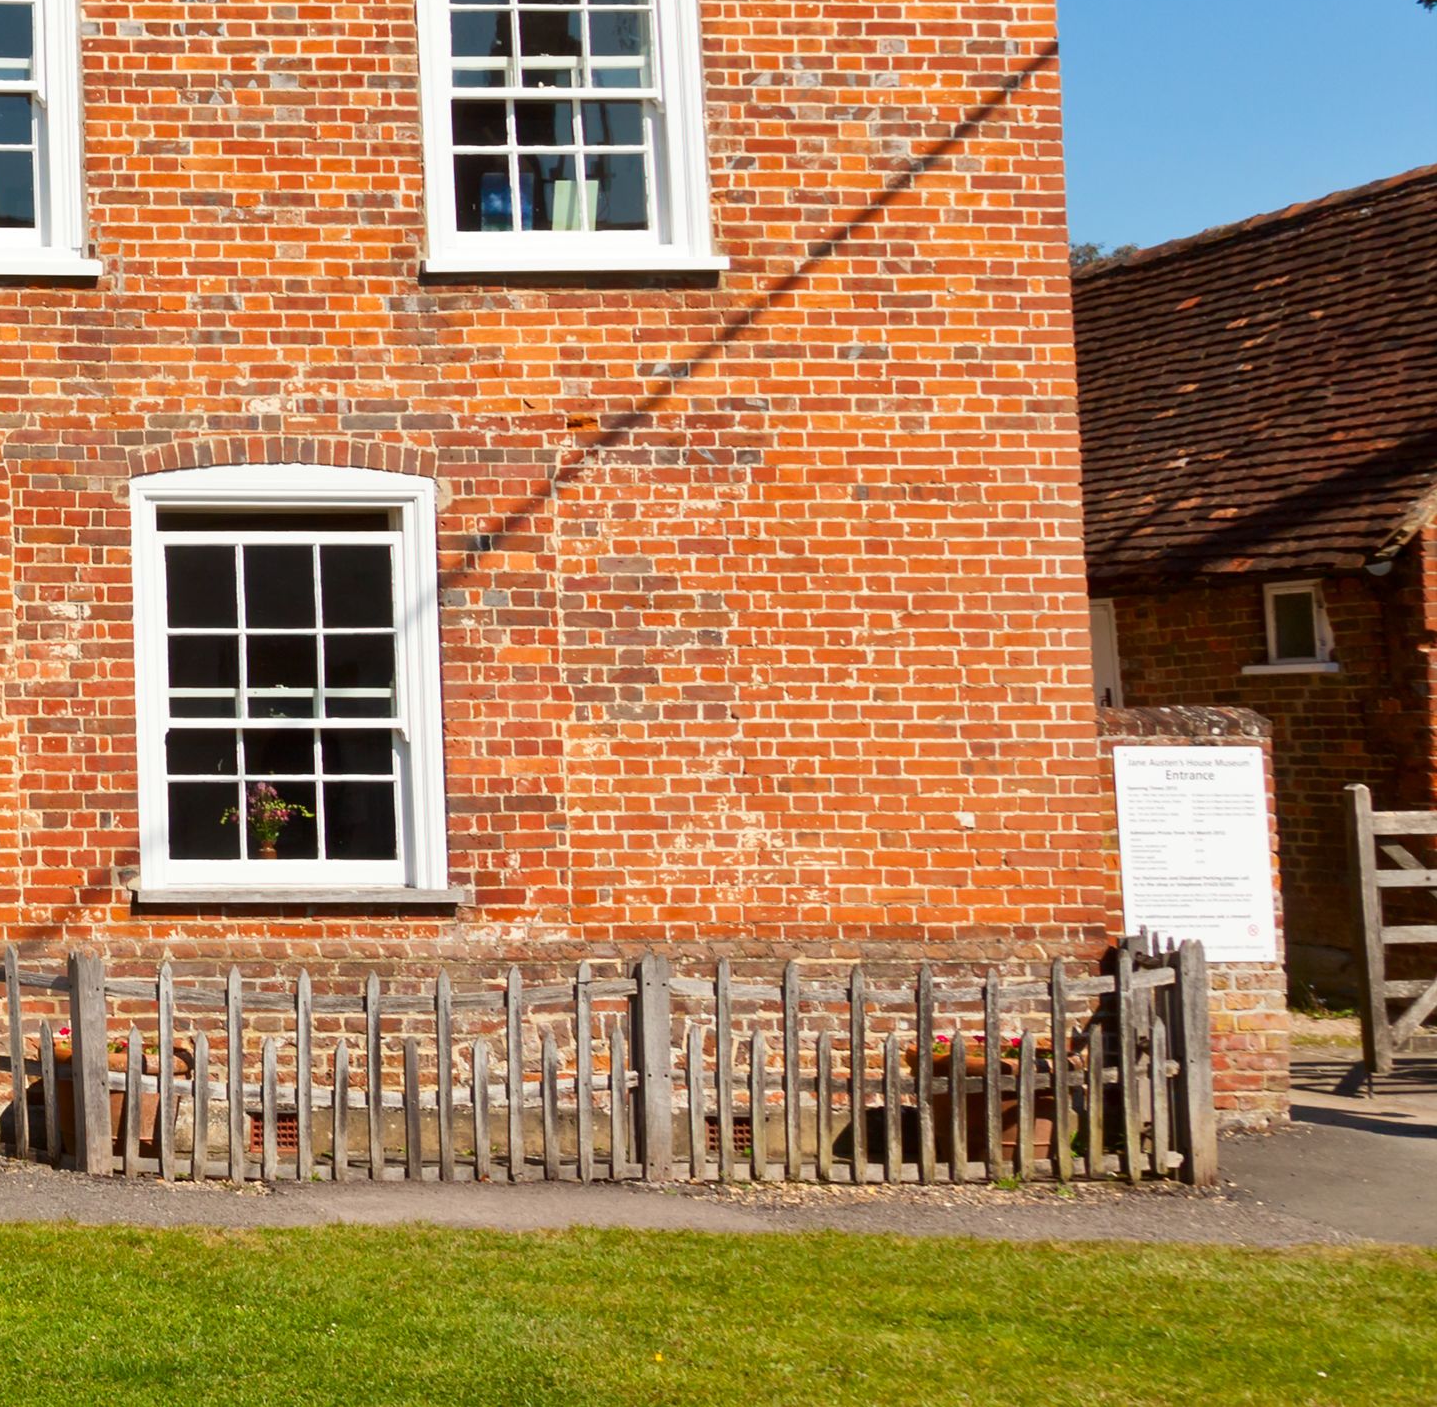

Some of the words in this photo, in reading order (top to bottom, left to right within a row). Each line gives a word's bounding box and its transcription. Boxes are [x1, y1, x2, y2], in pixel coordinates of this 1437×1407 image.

[1128, 758, 1146, 767] Jane
[1149, 758, 1185, 767] Austen's
[1186, 758, 1212, 767] House
[1214, 758, 1250, 767] Museum
[1165, 769, 1214, 780] Entrance
